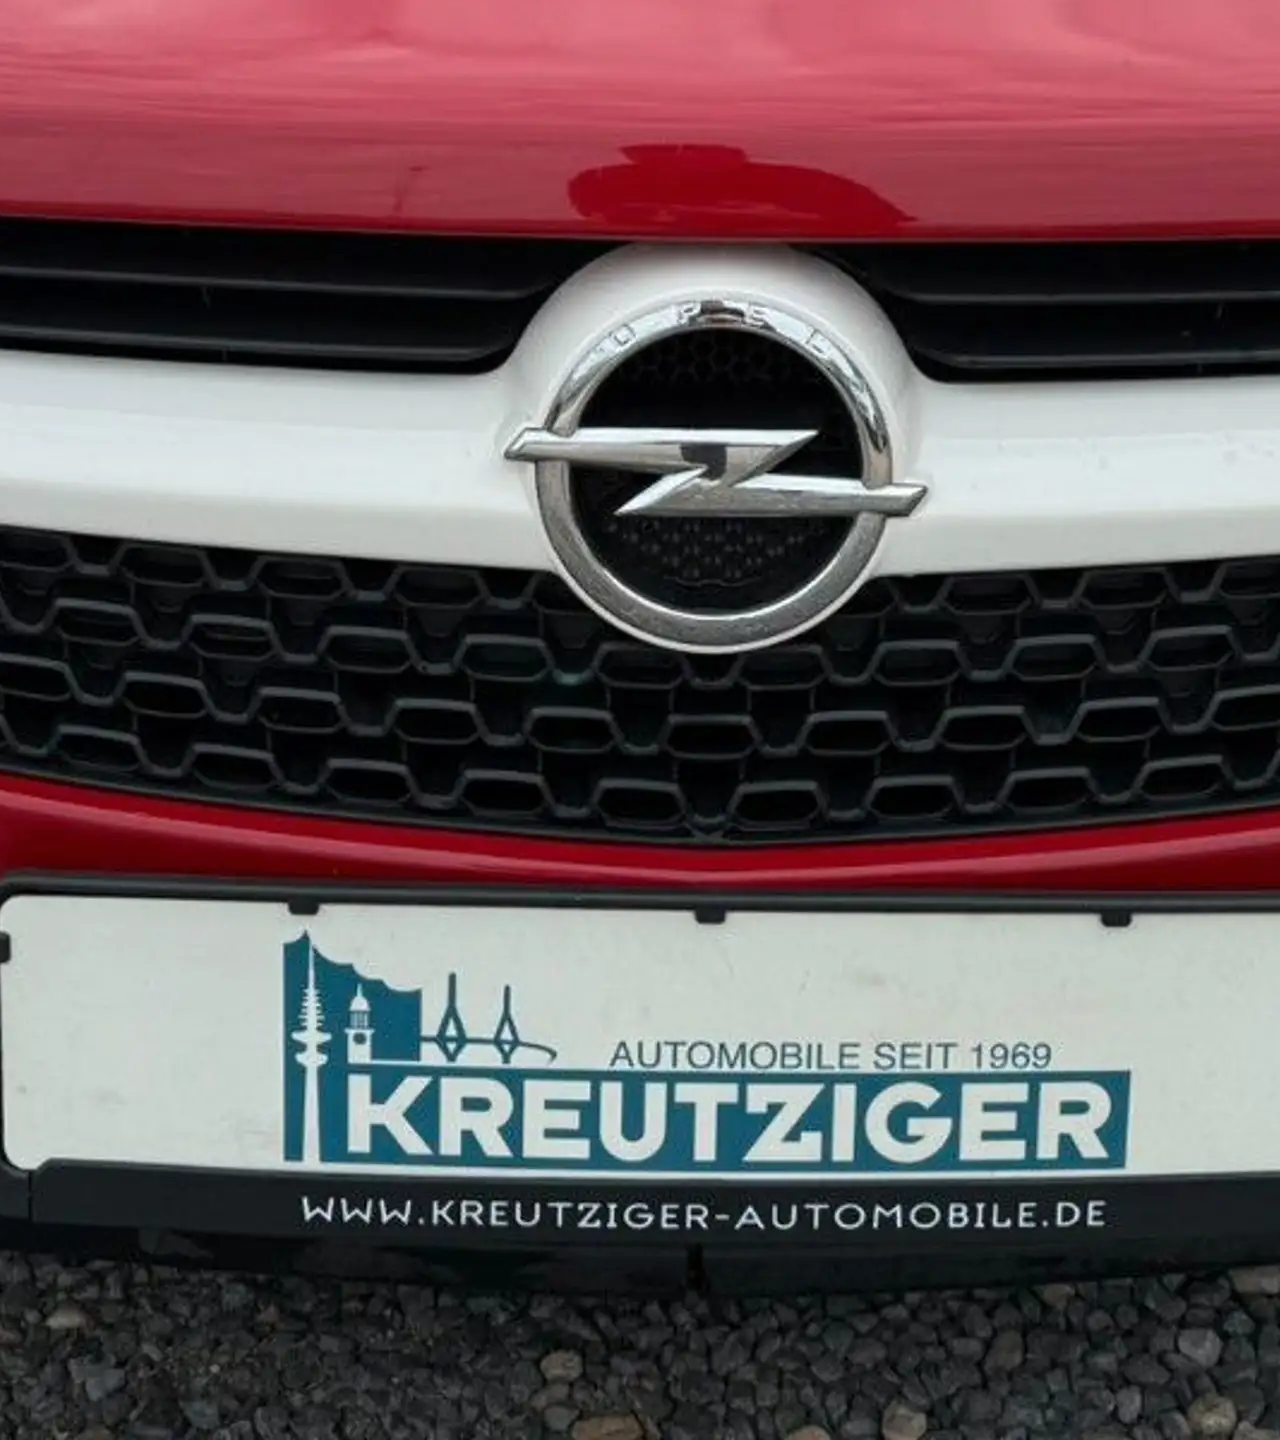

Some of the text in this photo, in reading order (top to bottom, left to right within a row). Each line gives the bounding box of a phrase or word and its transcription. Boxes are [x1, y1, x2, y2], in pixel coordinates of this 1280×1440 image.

[611, 301, 832, 359] OPEL
[609, 1040, 1053, 1070] AUTOMOBILE SEIT 1969
[347, 1074, 1113, 1163] KREUTZIGER
[301, 1195, 1107, 1230] WWW.KREUTZIGER-AUTOMOBILE.DE
